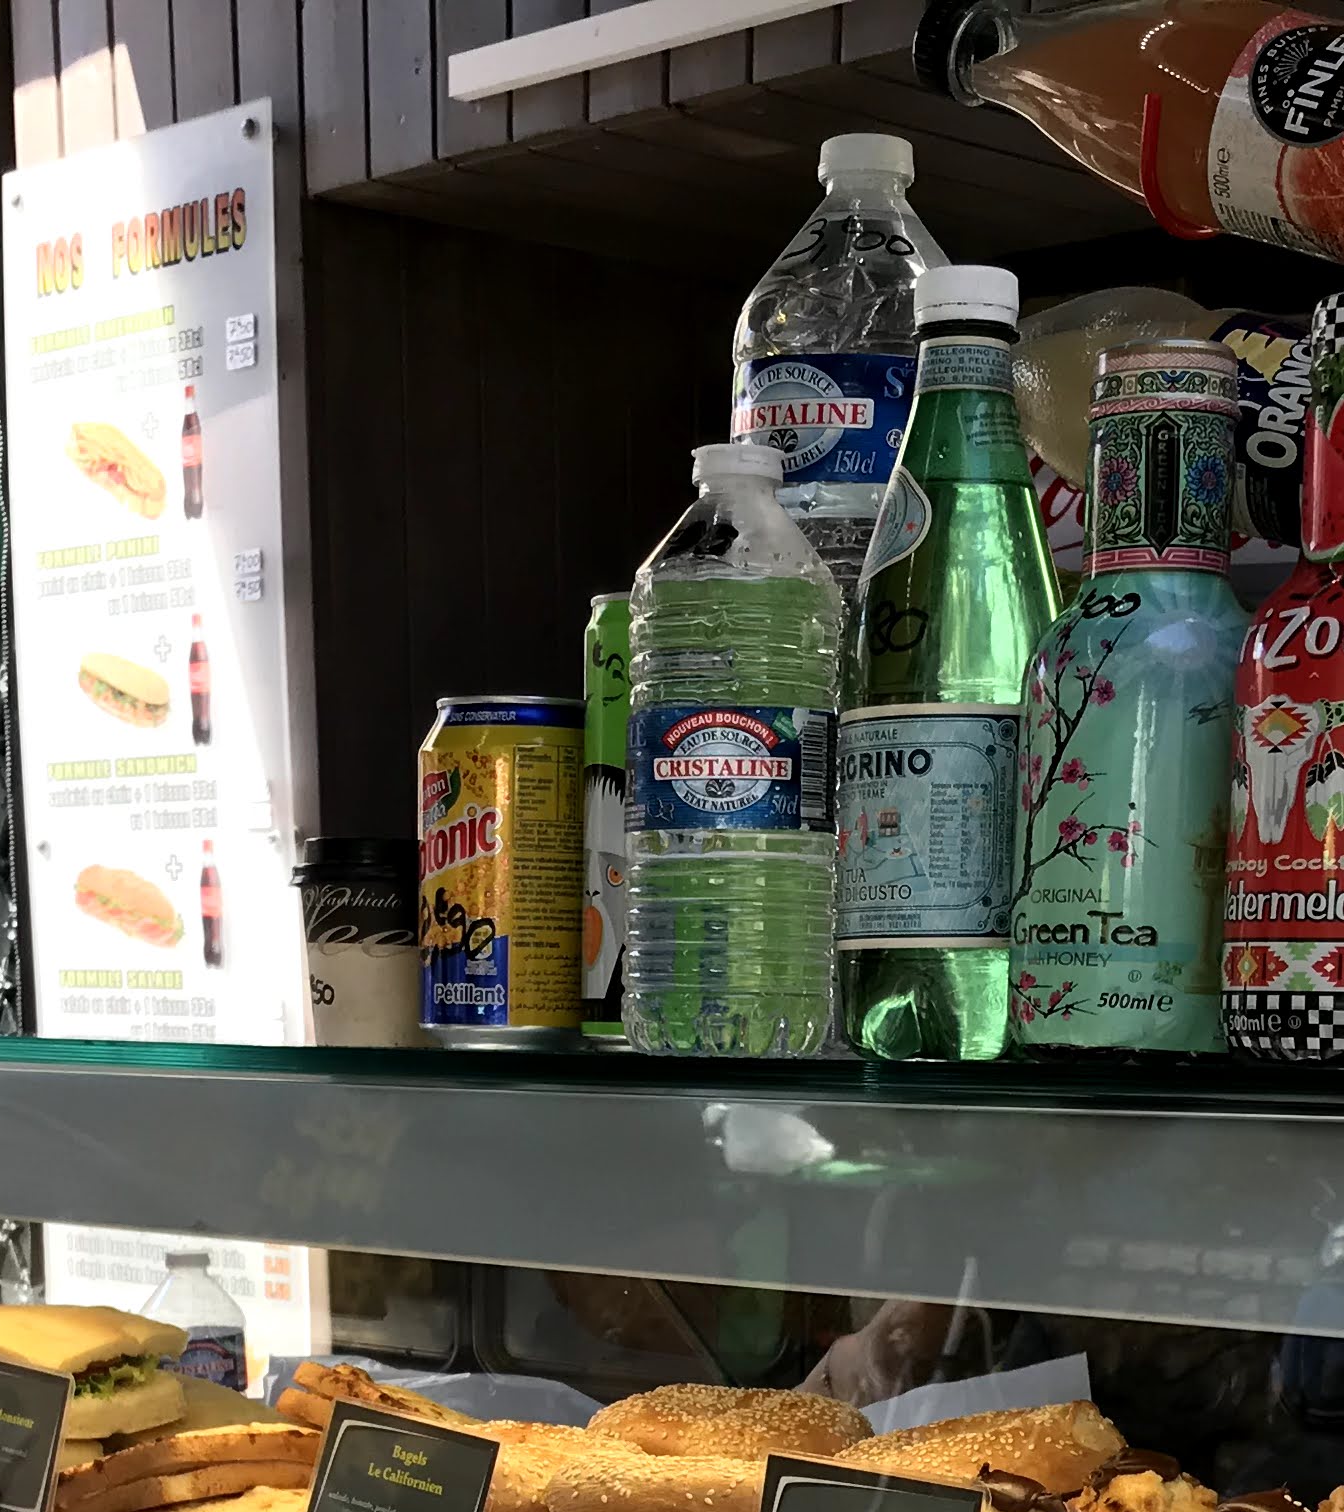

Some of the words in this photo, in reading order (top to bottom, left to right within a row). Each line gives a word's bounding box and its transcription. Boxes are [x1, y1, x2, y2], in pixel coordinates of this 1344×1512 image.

[1258, 64, 1275, 115] FINES
[36, 232, 84, 297] NOS
[112, 187, 247, 278] FORMULES
[930, 346, 991, 357] PELLEGRINO
[768, 366, 783, 382] DE
[784, 365, 834, 396] SOURCE
[1157, 430, 1169, 491] GREEN
[666, 713, 713, 745] NOUVEAU
[716, 713, 769, 738] BOUCHON
[680, 738, 700, 755] EAU
[703, 731, 719, 743] DE
[721, 730, 764, 753] SOURCE
[114, 753, 199, 778] SANDWICH
[656, 758, 789, 778] CRISTALINE
[710, 794, 759, 812] NATUREL
[858, 884, 913, 901] GUSTO
[1031, 888, 1108, 906] ORIGINAL
[1013, 915, 1089, 947] Green
[1088, 910, 1159, 947] Tea
[1045, 951, 1113, 968] HONEY
[435, 982, 506, 1006] Pétillant
[1096, 990, 1155, 1012] 500ml
[1229, 1015, 1265, 1032] 500ml
[391, 1444, 429, 1467] Bagels
[367, 1462, 381, 1478] Le
[382, 1466, 444, 1496] Californien
